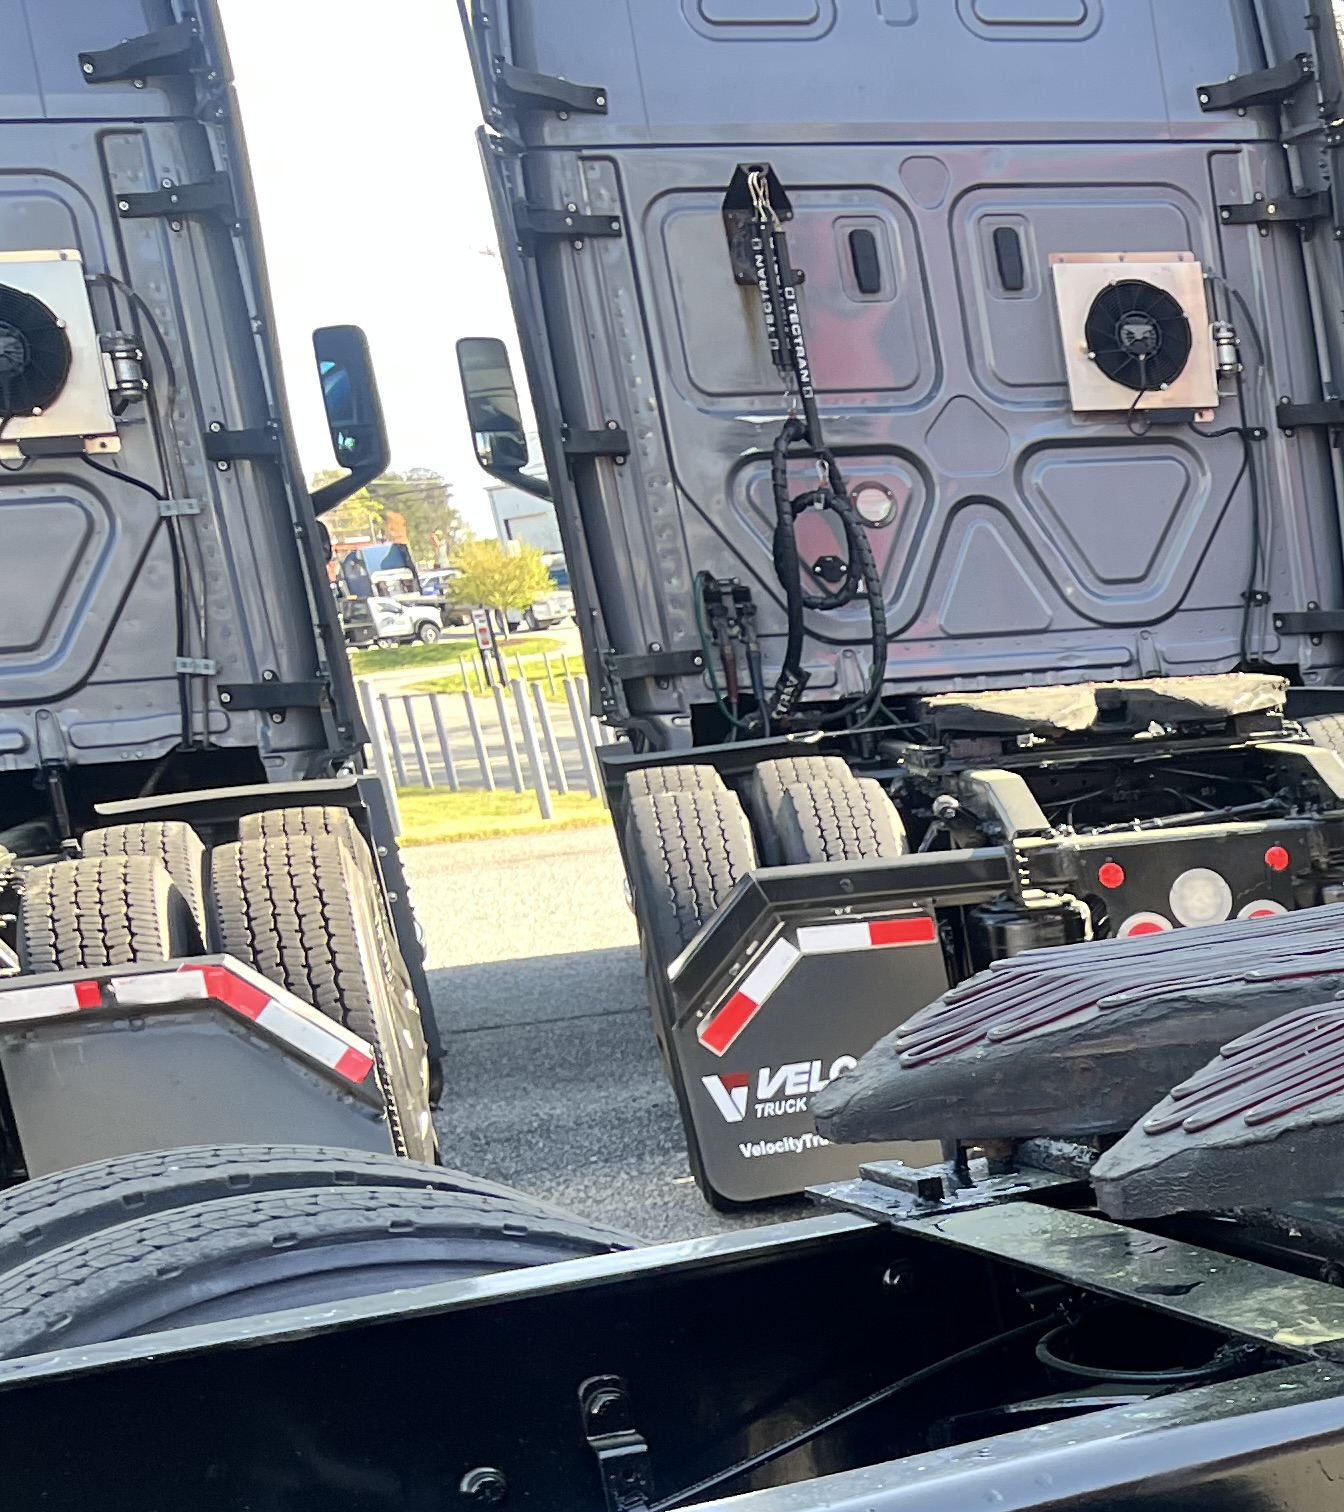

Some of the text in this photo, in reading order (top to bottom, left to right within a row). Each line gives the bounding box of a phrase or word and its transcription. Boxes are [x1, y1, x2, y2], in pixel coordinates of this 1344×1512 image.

[788, 303, 810, 382] TECTRAN
[755, 1097, 807, 1118] TRUCK
[739, 1132, 835, 1158] VelocityTru
